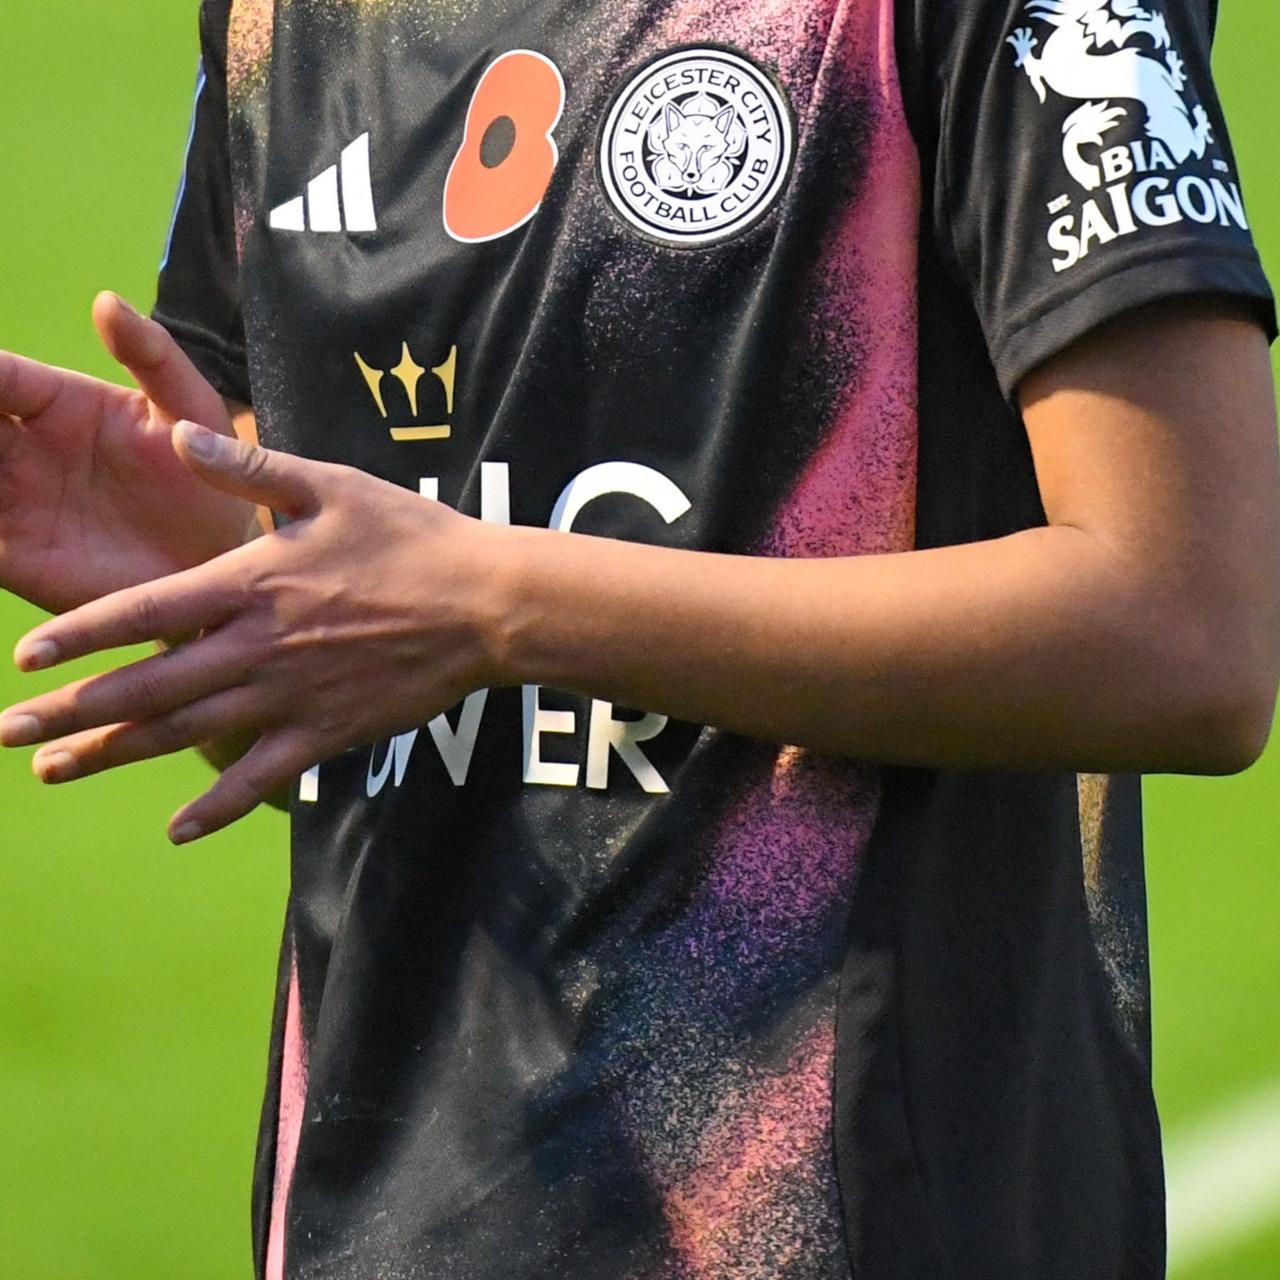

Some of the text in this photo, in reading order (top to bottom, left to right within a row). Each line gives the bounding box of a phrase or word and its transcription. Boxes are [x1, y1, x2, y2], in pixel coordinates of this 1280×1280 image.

[624, 68, 773, 144] LEICESTER CITY
[620, 151, 769, 223] FOOTBALL CLUB
[1100, 140, 1177, 183] BIA
[1047, 175, 1249, 273] SAIGON
